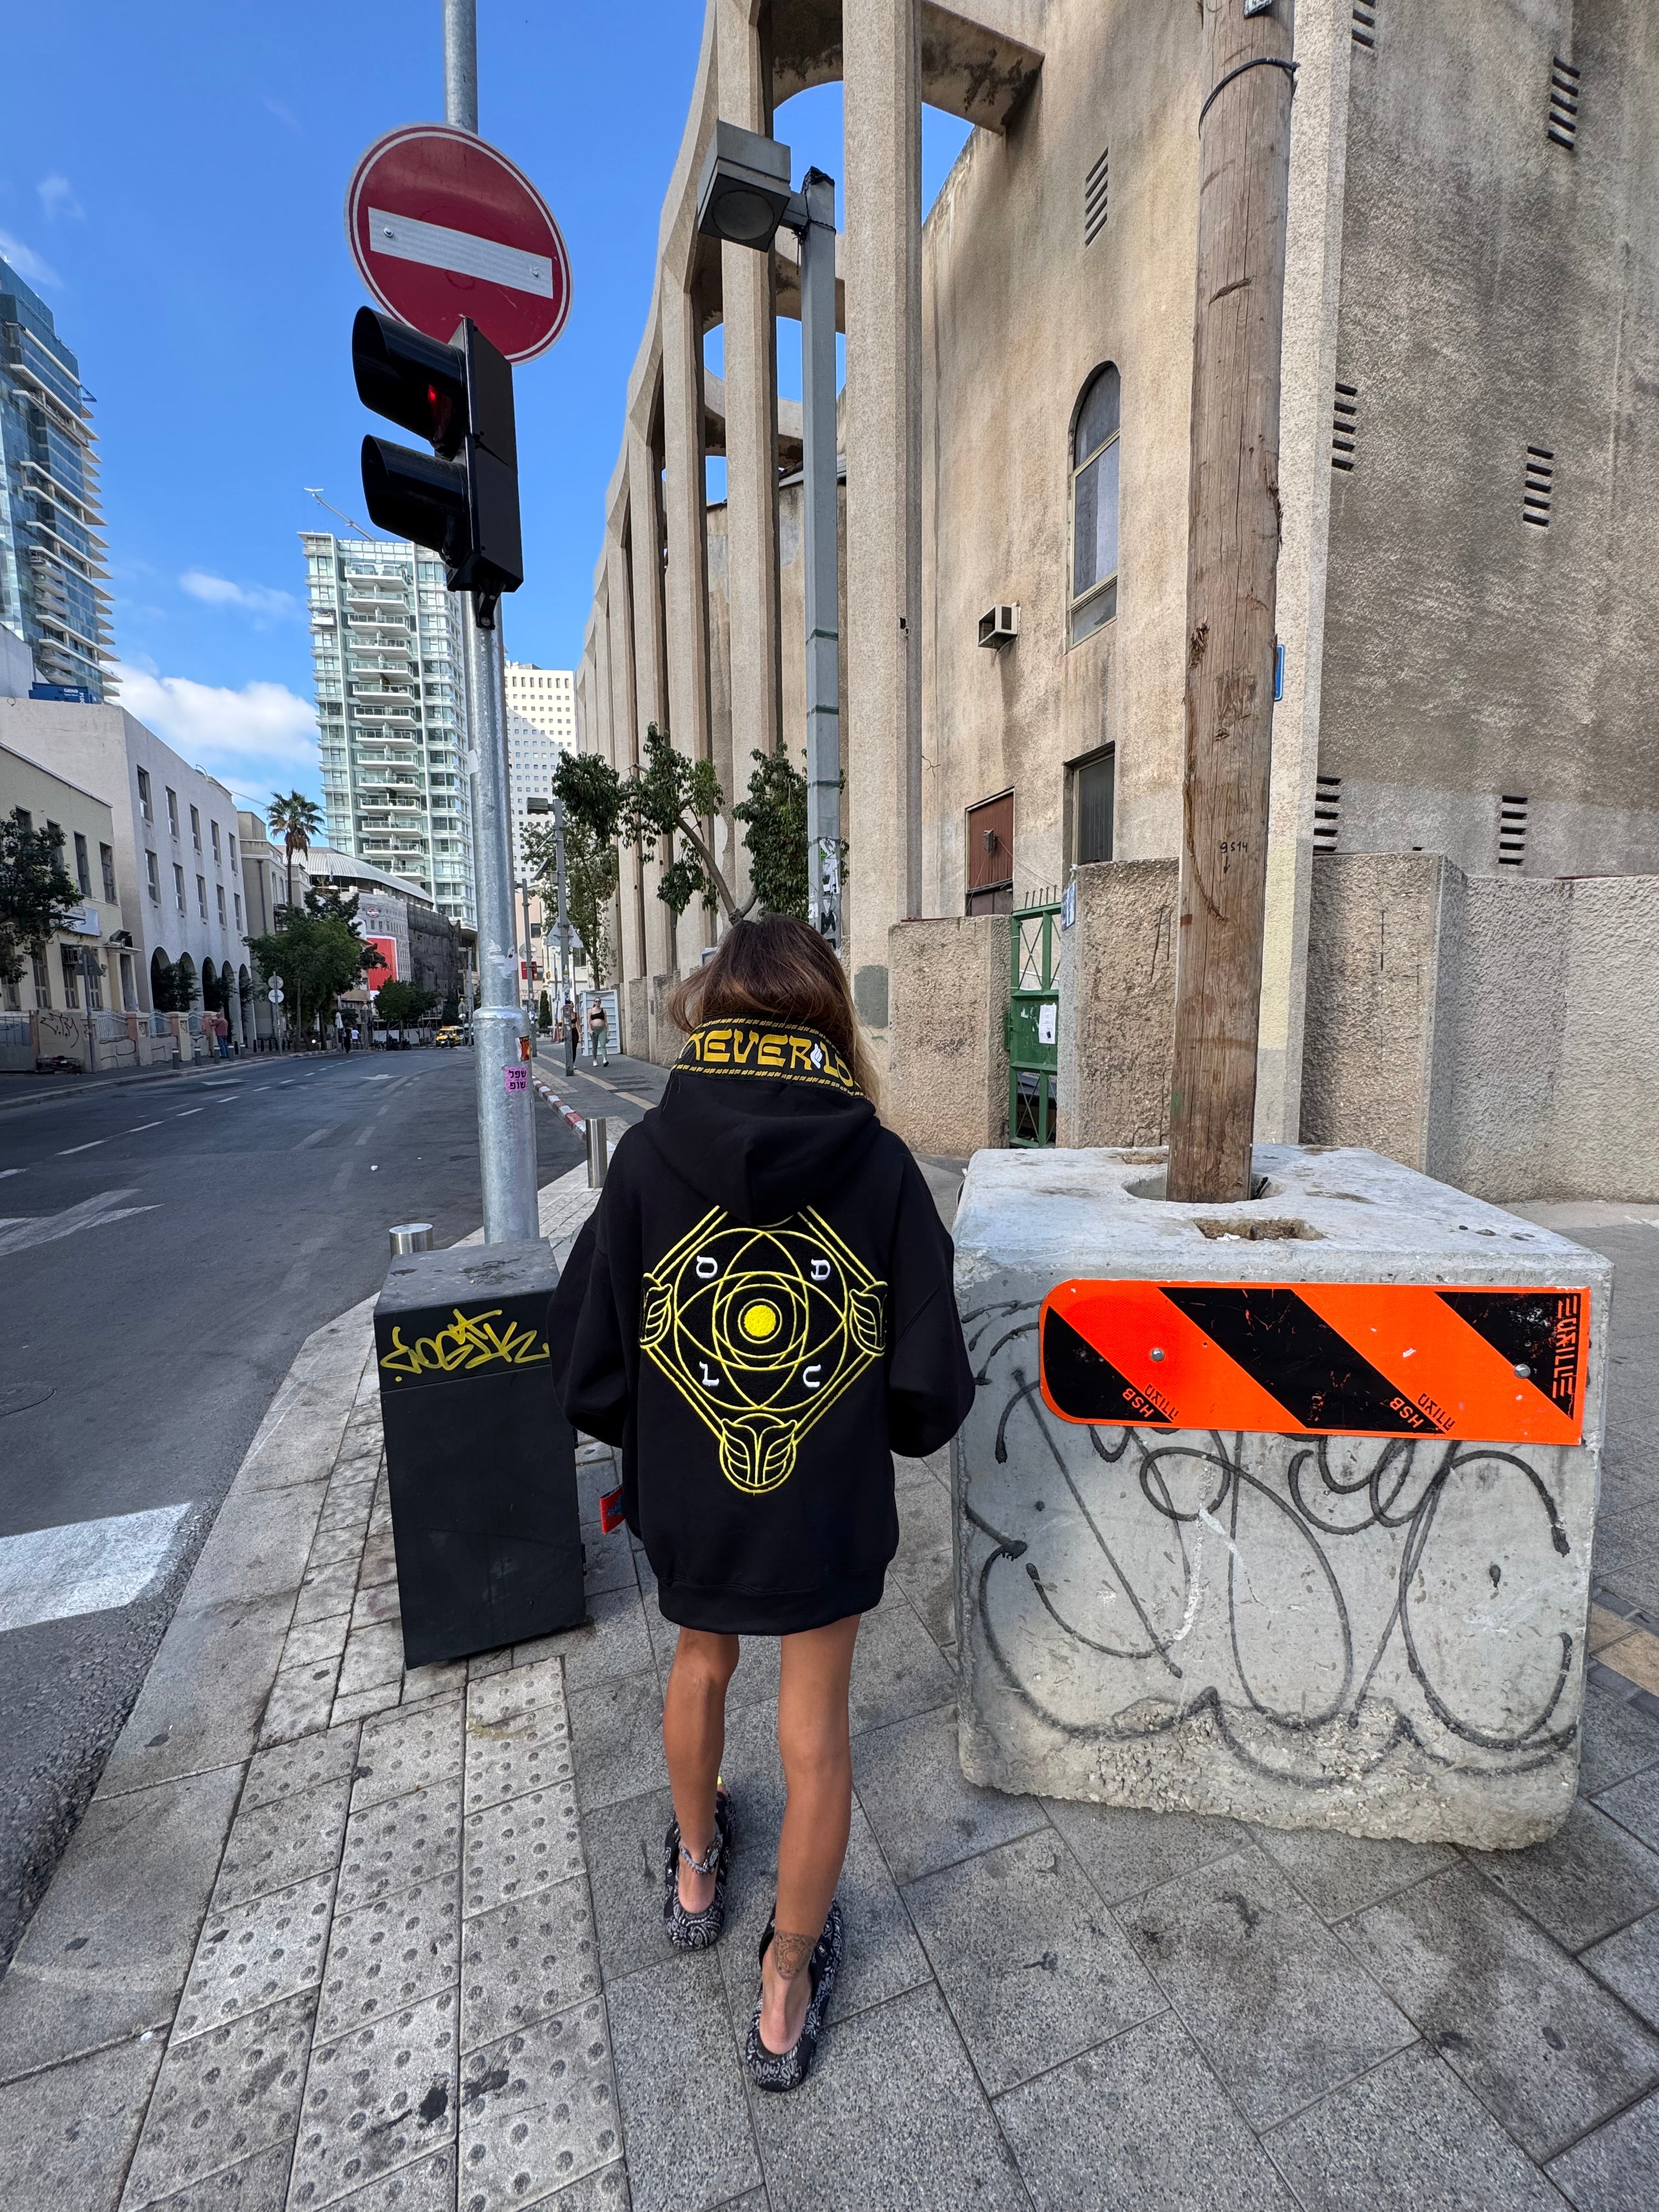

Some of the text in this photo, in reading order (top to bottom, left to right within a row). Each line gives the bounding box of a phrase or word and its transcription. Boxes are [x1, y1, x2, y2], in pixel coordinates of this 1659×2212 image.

[509, 1070, 527, 1079] שפל
[820, 1041, 861, 1089] LO
[1554, 1317, 1577, 1379] מצודה
[1122, 1388, 1154, 1418] HSB
[1144, 1383, 1180, 1420] מצודה
[1390, 1397, 1424, 1429] HSB
[1417, 1392, 1456, 1431] מצודה
